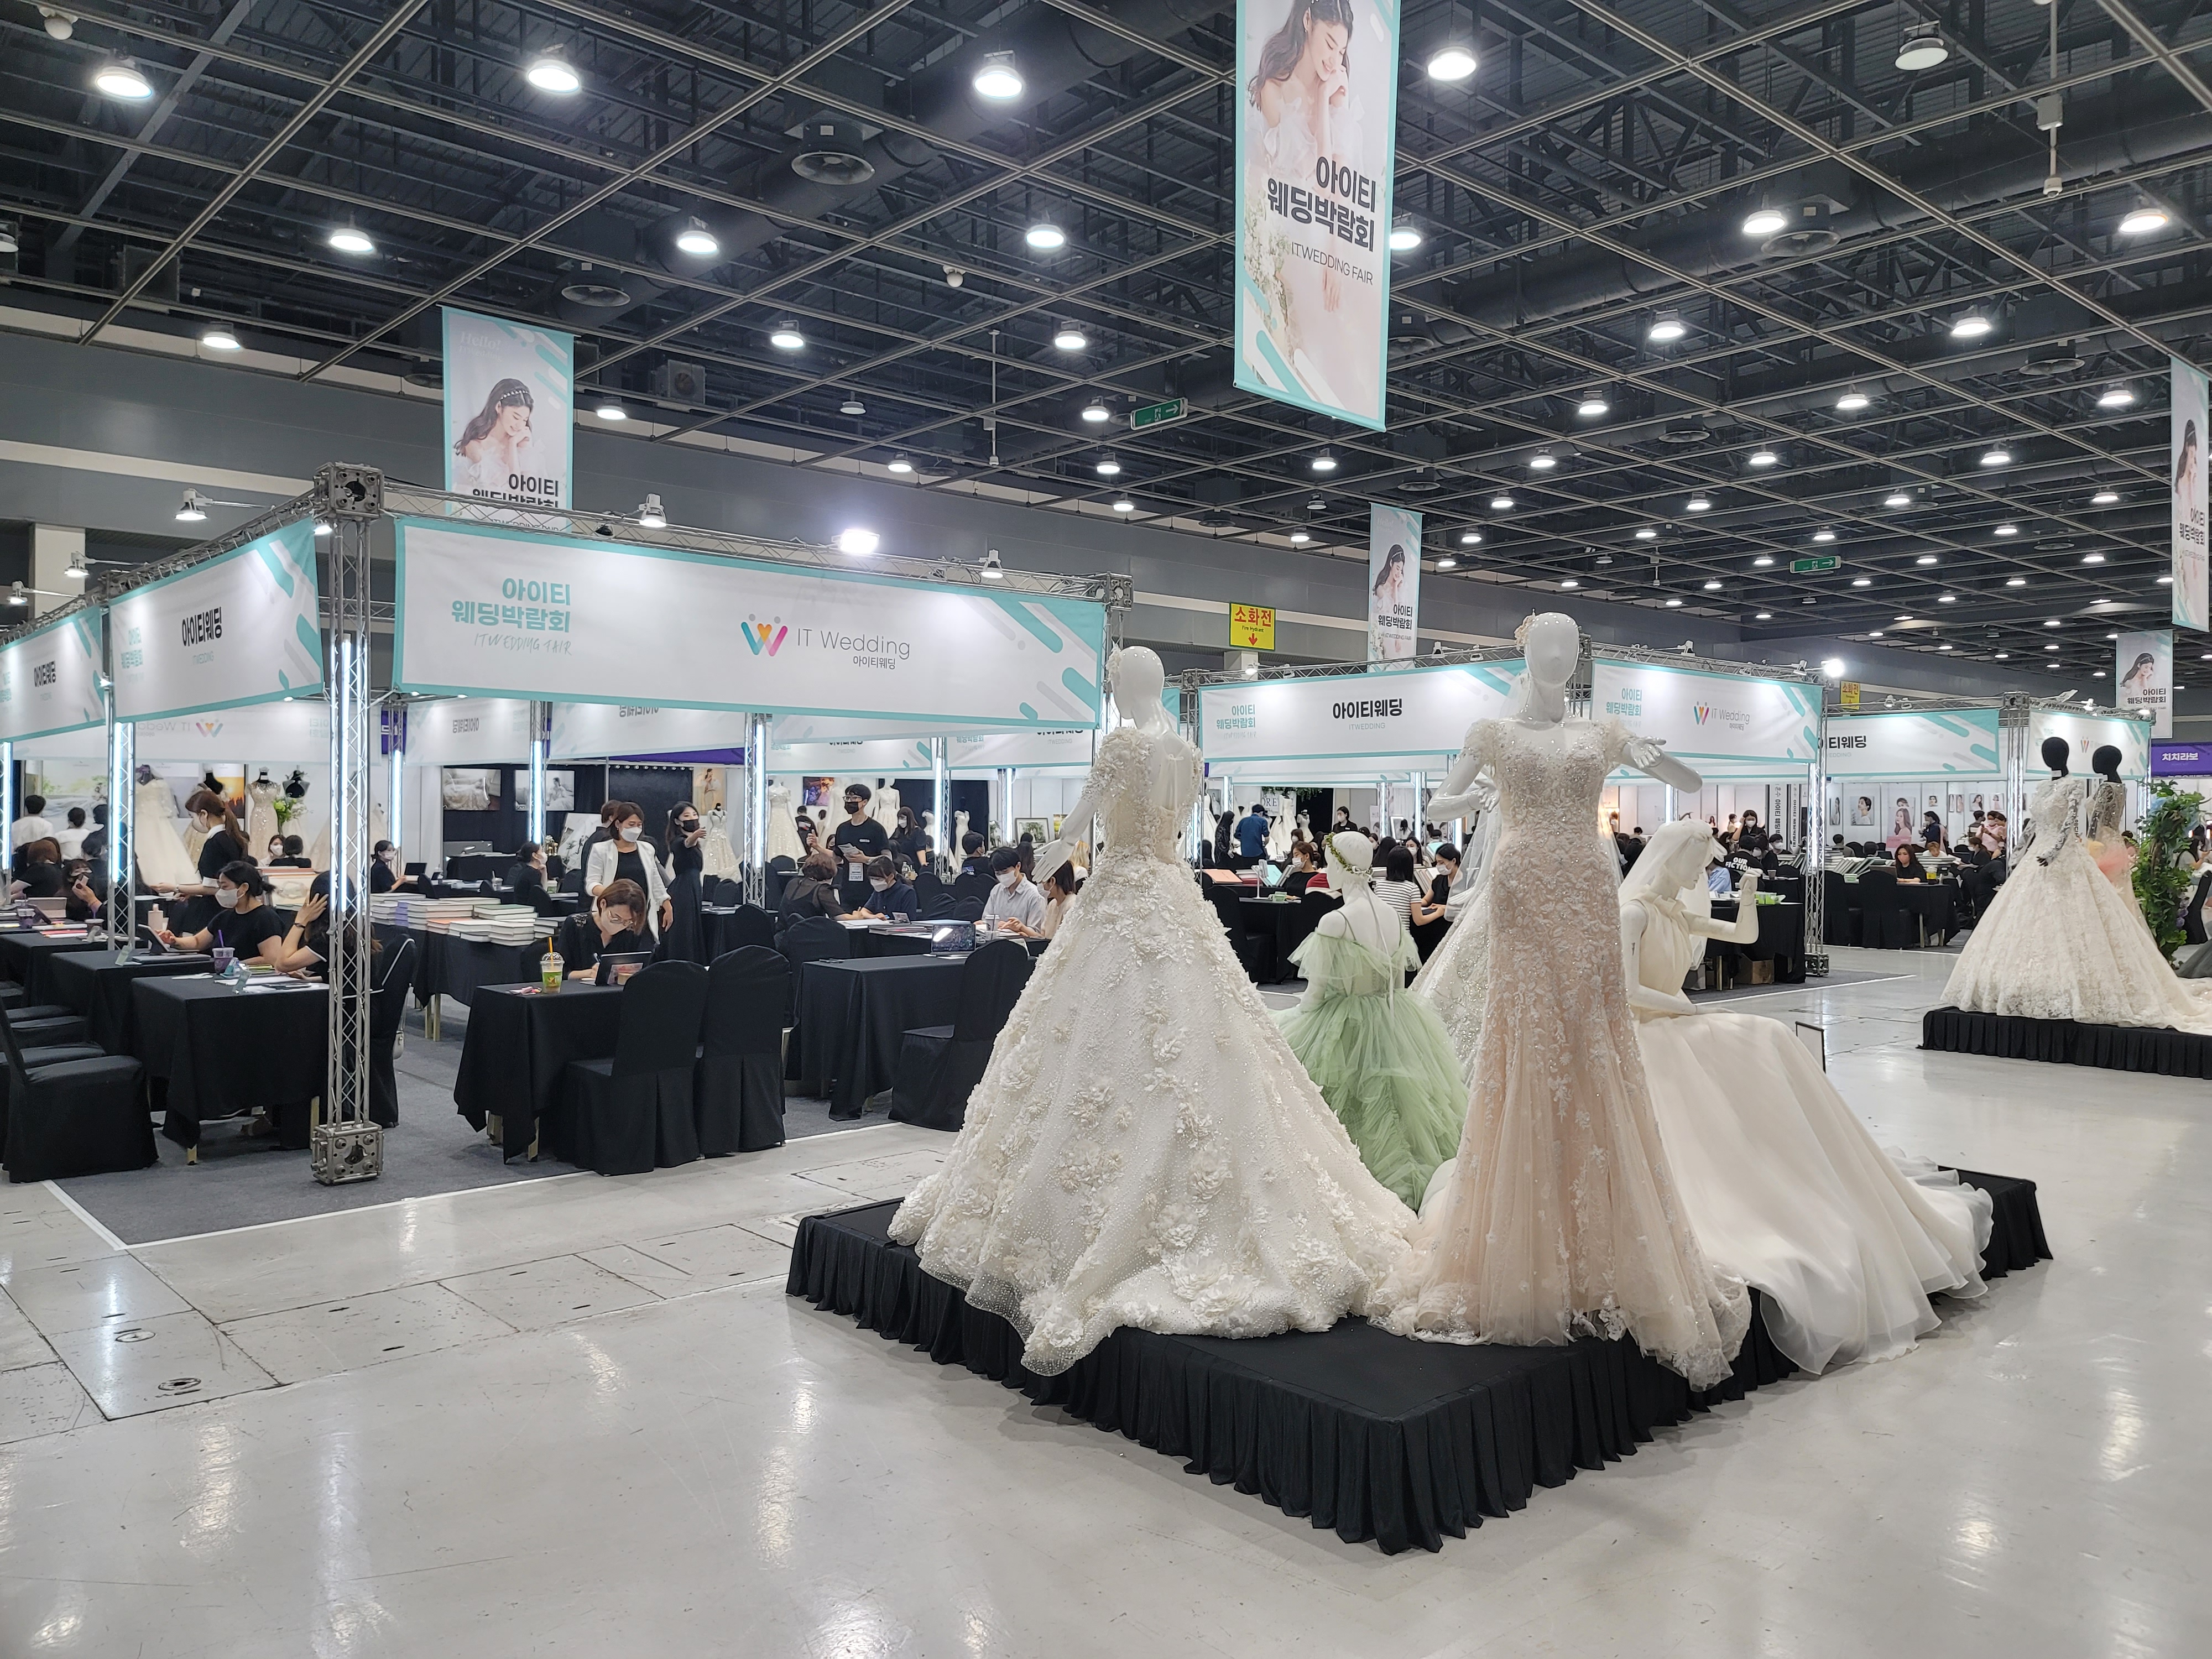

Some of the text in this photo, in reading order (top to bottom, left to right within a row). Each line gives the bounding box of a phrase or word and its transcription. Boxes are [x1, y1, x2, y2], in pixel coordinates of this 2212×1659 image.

[1316, 156, 1376, 213] 아이티
[1267, 178, 1375, 252] 웨딩박람회
[1292, 242, 1373, 285] ITWEDDING FAIR
[509, 473, 559, 497] 아이티
[502, 578, 571, 606] 아이티
[451, 600, 571, 633] 웨딩박람회
[1234, 606, 1271, 627] 소화전
[1393, 604, 1413, 618] 아이티
[181, 606, 222, 647] 아이티웨딩
[1378, 614, 1412, 630] 웨딩박람회
[543, 640, 572, 656] FAIR
[797, 628, 910, 660] IT Wedding
[853, 655, 896, 670] 아이티웨딩
[1621, 687, 1642, 702] 아이티
[2127, 696, 2167, 705] 웨딩박람회
[1232, 703, 1255, 716] 아이티
[1332, 698, 1402, 719] 아이티웨딩
[1606, 701, 1642, 717] 웨딩박람회
[1711, 708, 1750, 725] IT Wedding
[1216, 717, 1256, 730] 웨딩박람회
[1348, 722, 1386, 731] ITWEDDING
[2162, 752, 2199, 761] 치치라보
[1733, 857, 1748, 865] OUR
